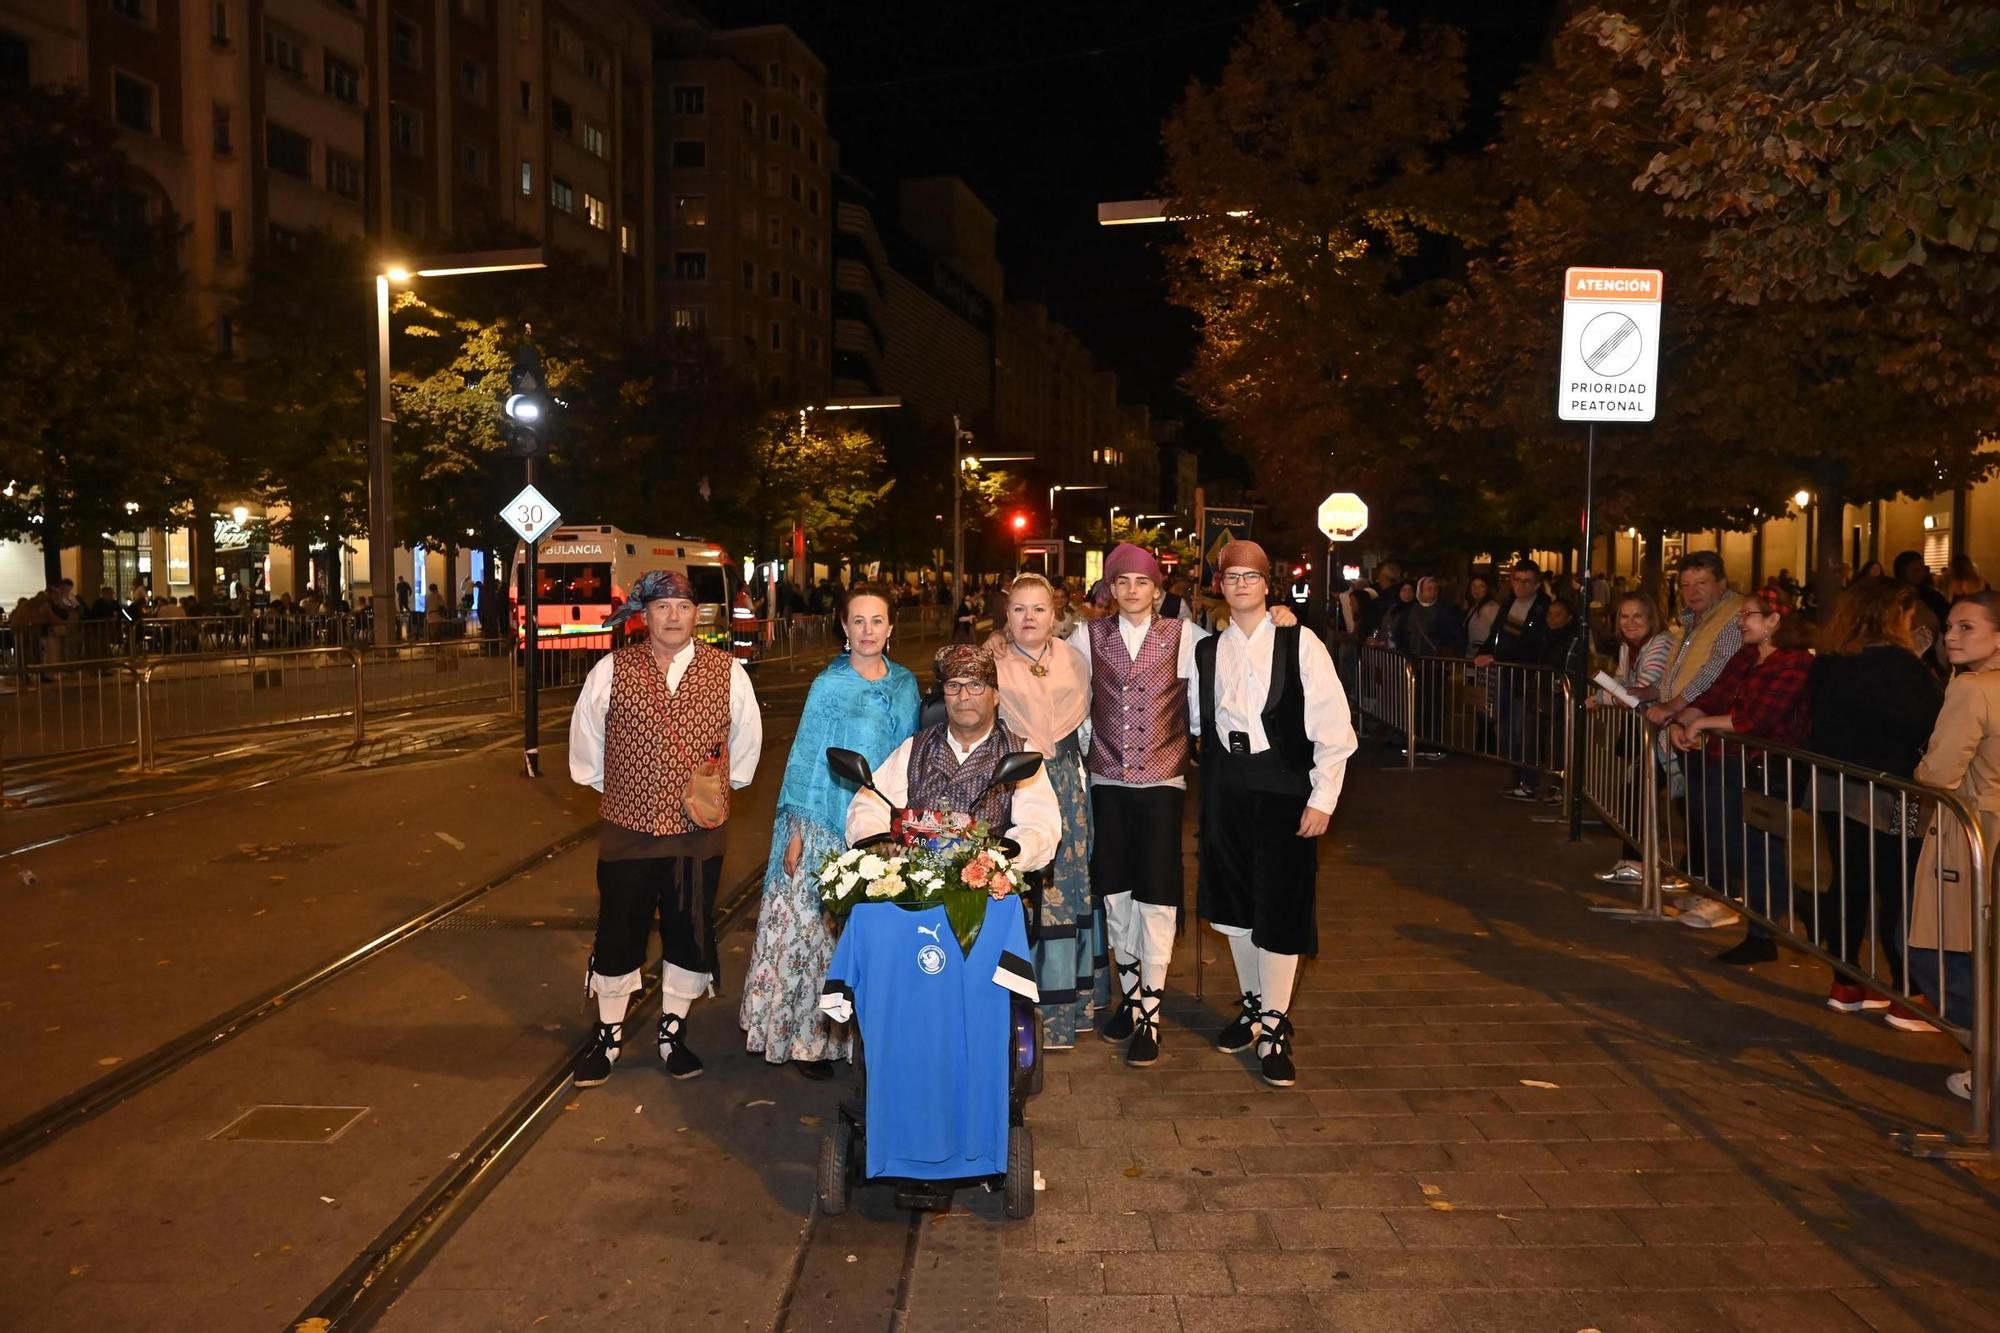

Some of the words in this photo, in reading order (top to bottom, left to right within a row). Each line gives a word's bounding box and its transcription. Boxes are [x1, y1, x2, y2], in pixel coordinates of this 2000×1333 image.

[1576, 278, 1651, 293] ATENCIÓN
[1571, 382, 1647, 395] PRIORIDAD
[1571, 400, 1645, 412] PEATONAL
[517, 504, 543, 524] 30
